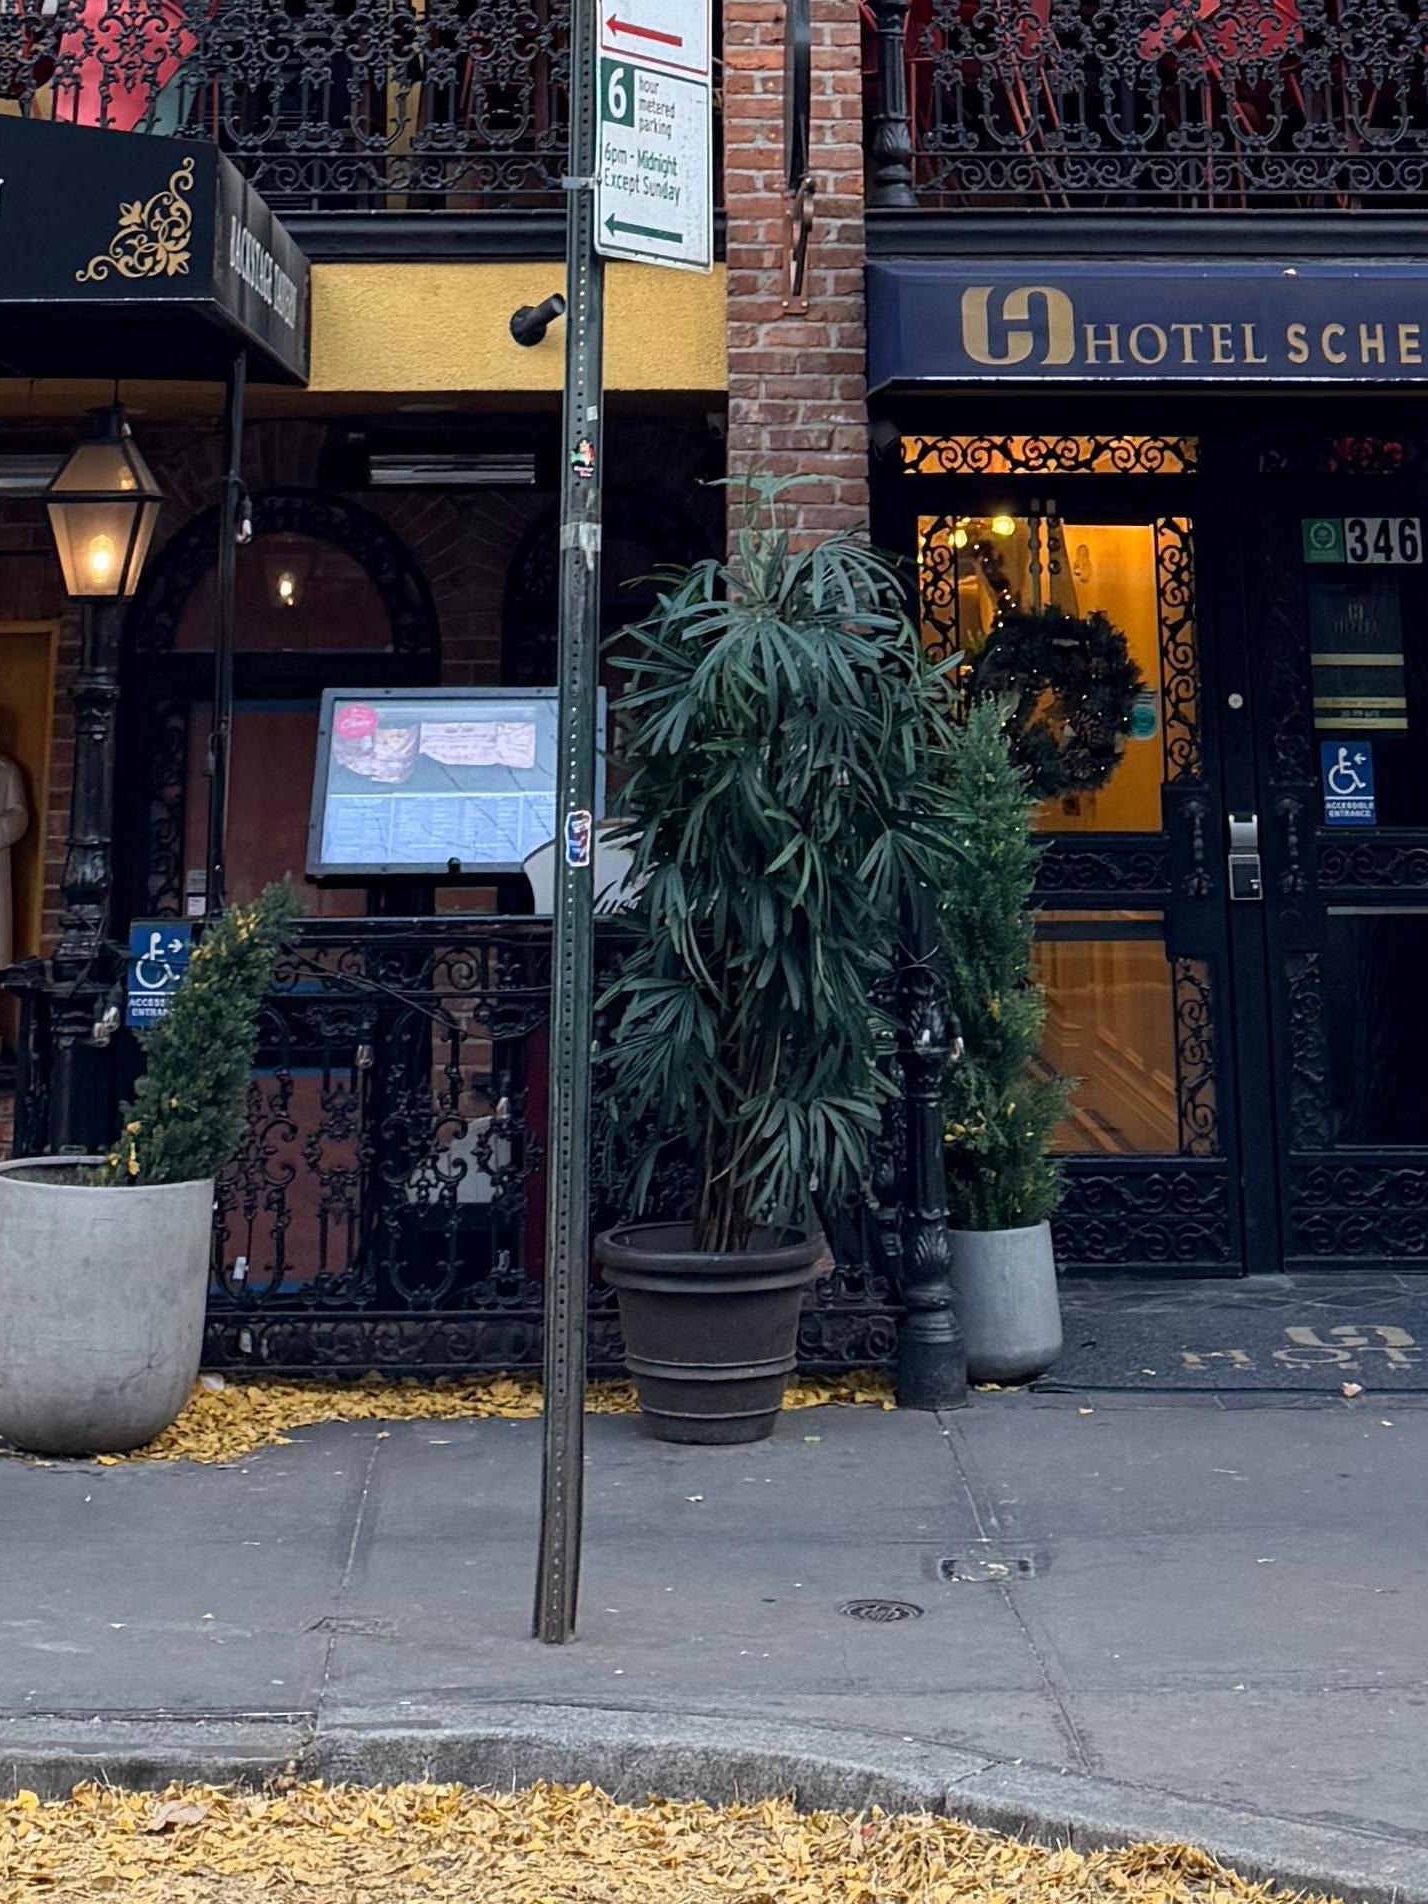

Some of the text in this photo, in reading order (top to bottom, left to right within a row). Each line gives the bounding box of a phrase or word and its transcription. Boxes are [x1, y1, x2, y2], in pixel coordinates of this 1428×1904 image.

[608, 67, 627, 119] 6
[639, 74, 660, 94] hour
[639, 98, 676, 119] metered
[639, 117, 672, 140] parking
[604, 142, 627, 166] 6pm
[637, 148, 678, 179] Midnight
[604, 167, 681, 207] Except Sunday
[1083, 322, 1269, 365] HOTEL
[1347, 518, 1419, 562] 346
